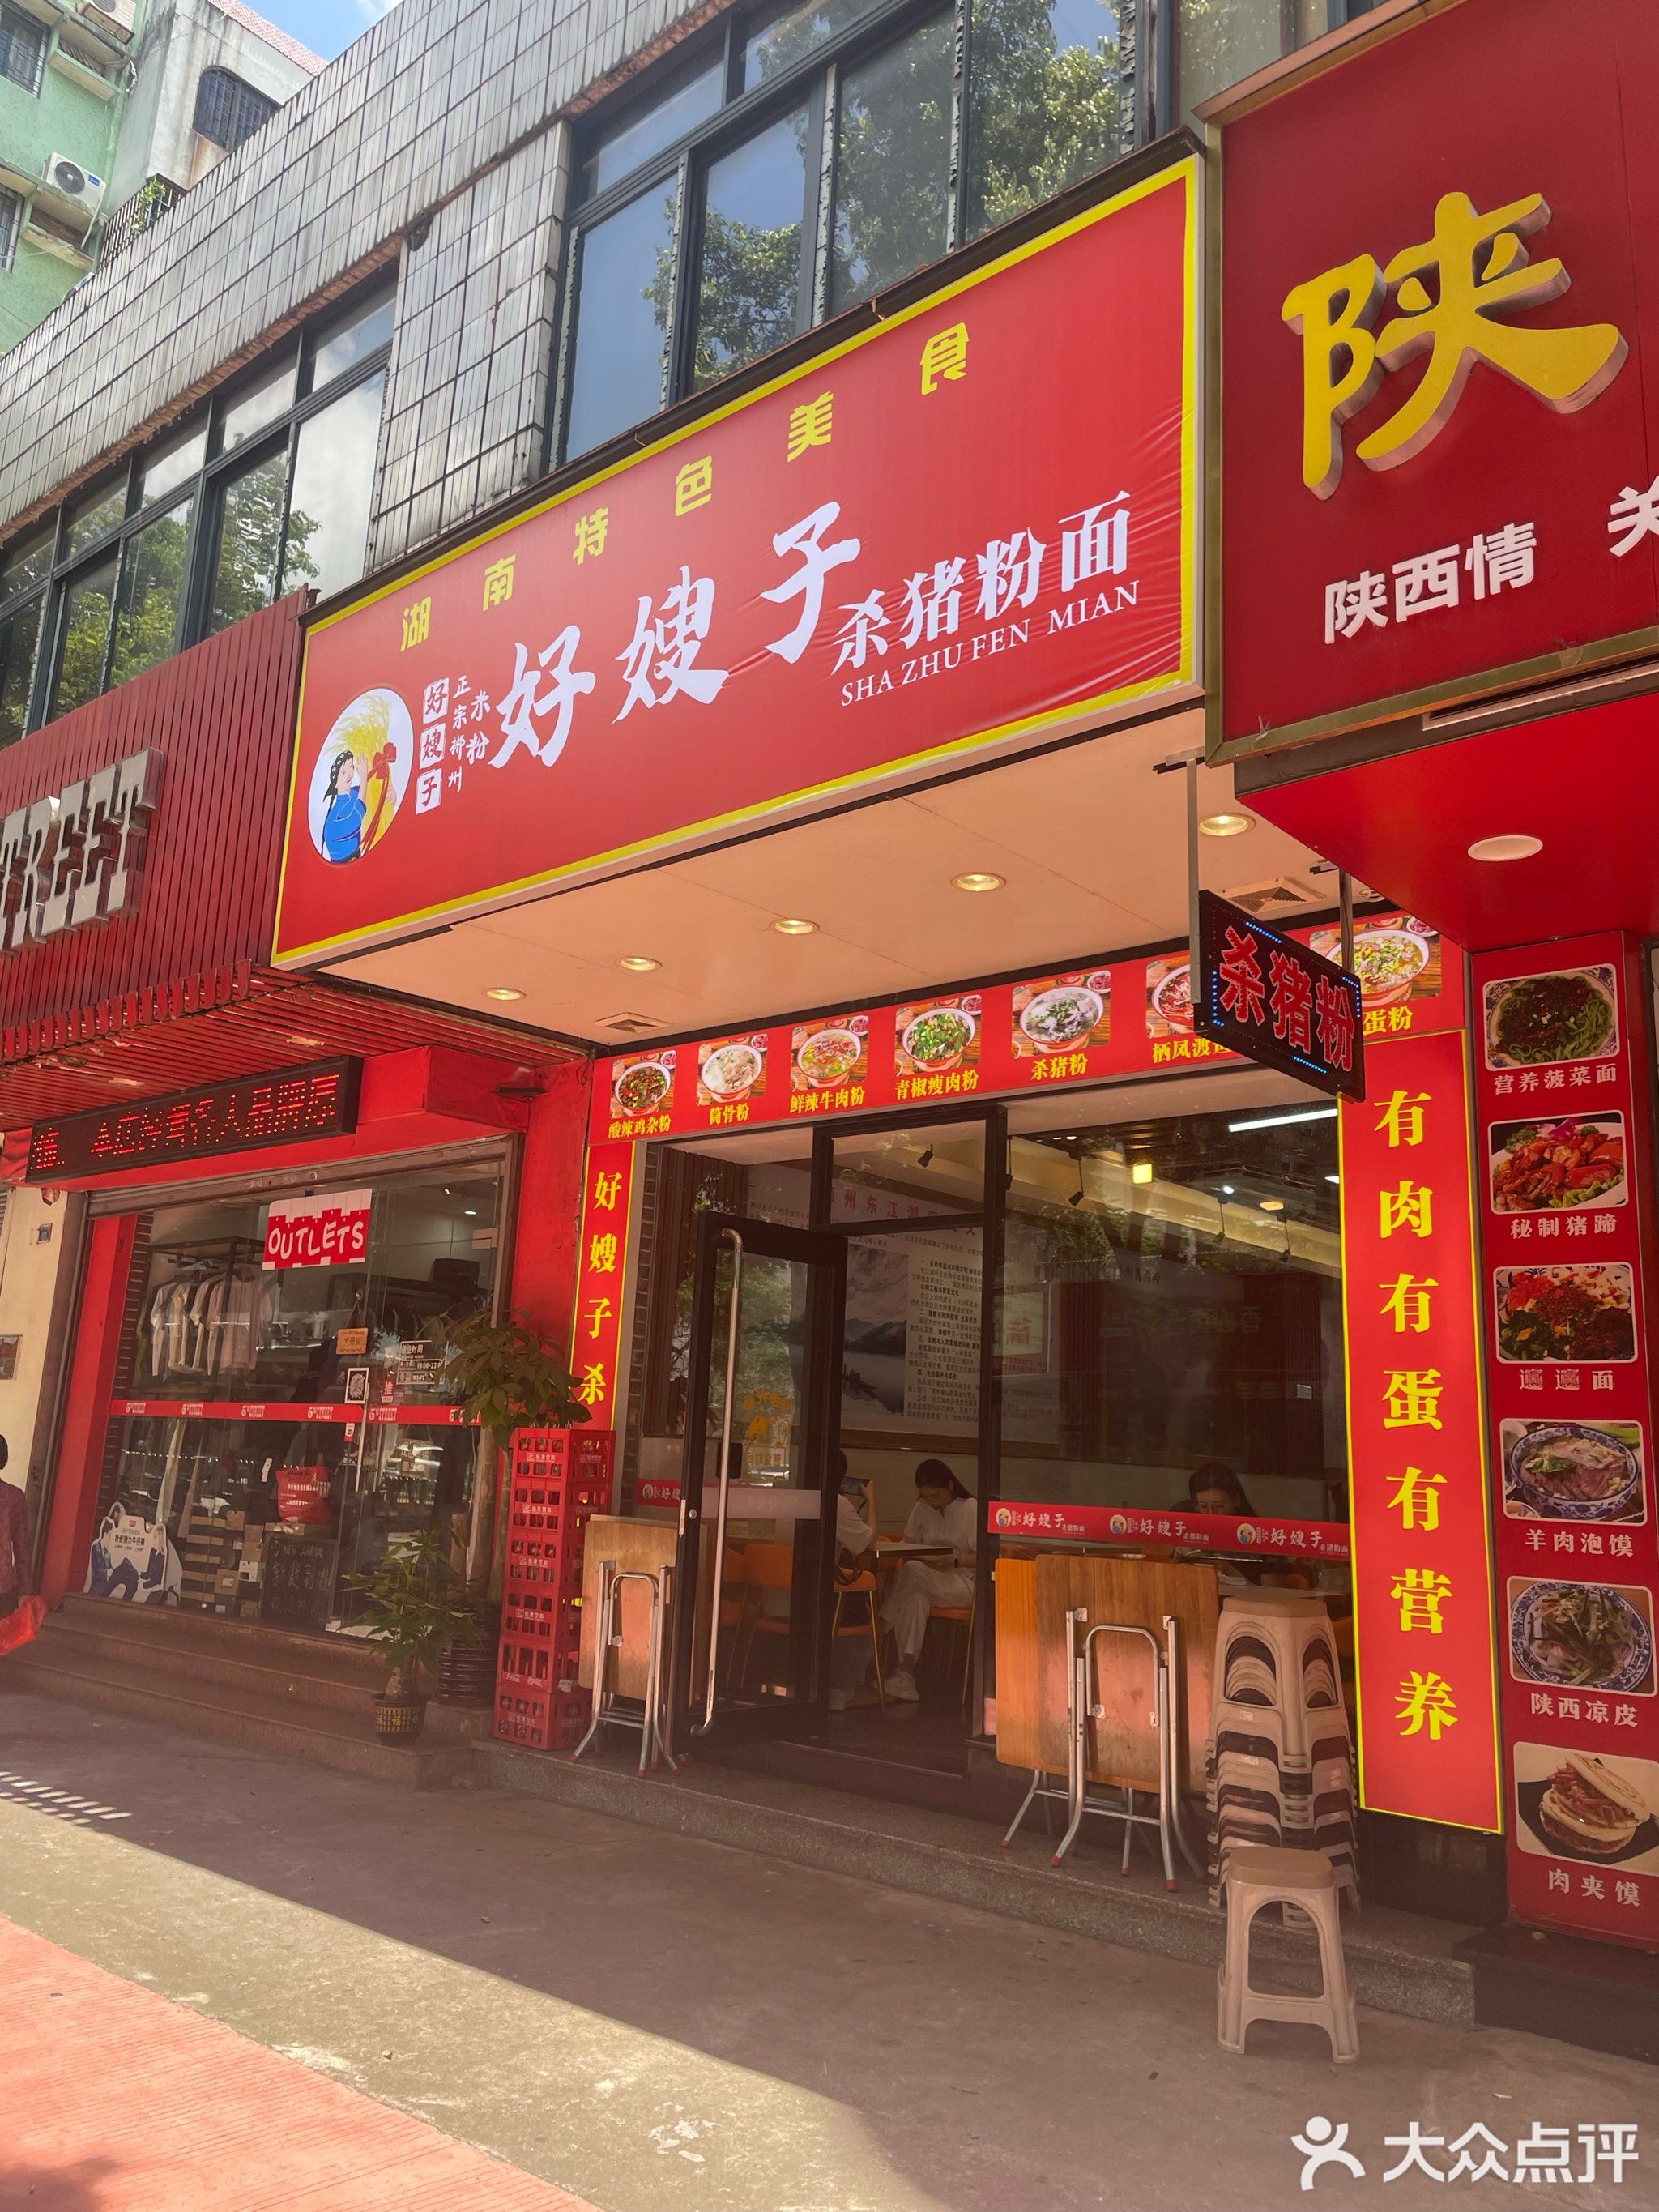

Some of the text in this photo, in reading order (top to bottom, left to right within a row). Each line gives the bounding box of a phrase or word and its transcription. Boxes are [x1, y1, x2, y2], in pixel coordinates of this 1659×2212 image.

[1282, 192, 1628, 500] 陕
[399, 322, 970, 651] 湖南特色美食
[831, 490, 1131, 676] 杀猪粉面
[1324, 522, 1537, 645] 陕西情
[488, 501, 861, 768] 好嫂子
[841, 580, 1141, 707] SHA ZHU FEN MIAN
[465, 689, 491, 765] 米粉
[419, 681, 449, 809] 好嫂子
[1220, 925, 1356, 1072] 杀猪粉
[1363, 1006, 1414, 1036] 蛋粉
[1031, 1053, 1088, 1081] 杀猪粉
[1494, 1062, 1617, 1095] 营养菠菜面
[790, 1086, 864, 1114] 鲜辣牛肉粉
[894, 1069, 979, 1100] 青椒瘦肉粉
[608, 1114, 672, 1139] 酸辣鸡杂粉
[709, 1103, 749, 1126] 筒骨粉
[268, 1219, 365, 1260] OUTLETS
[1511, 1215, 1617, 1240] 秘制猪蹄
[383, 1381, 394, 1395] 推
[1373, 1090, 1458, 1740] 有肉有蛋有营养
[1021, 1511, 1065, 1529] 好嫂子
[1139, 1518, 1187, 1538] 好嫂子
[1269, 1527, 1323, 1548] 好嫂子
[1525, 1529, 1634, 1557] 羊肉泡馍
[1530, 1692, 1638, 1727] 陕西凉皮
[1548, 1868, 1640, 1907] 肉夹馍
